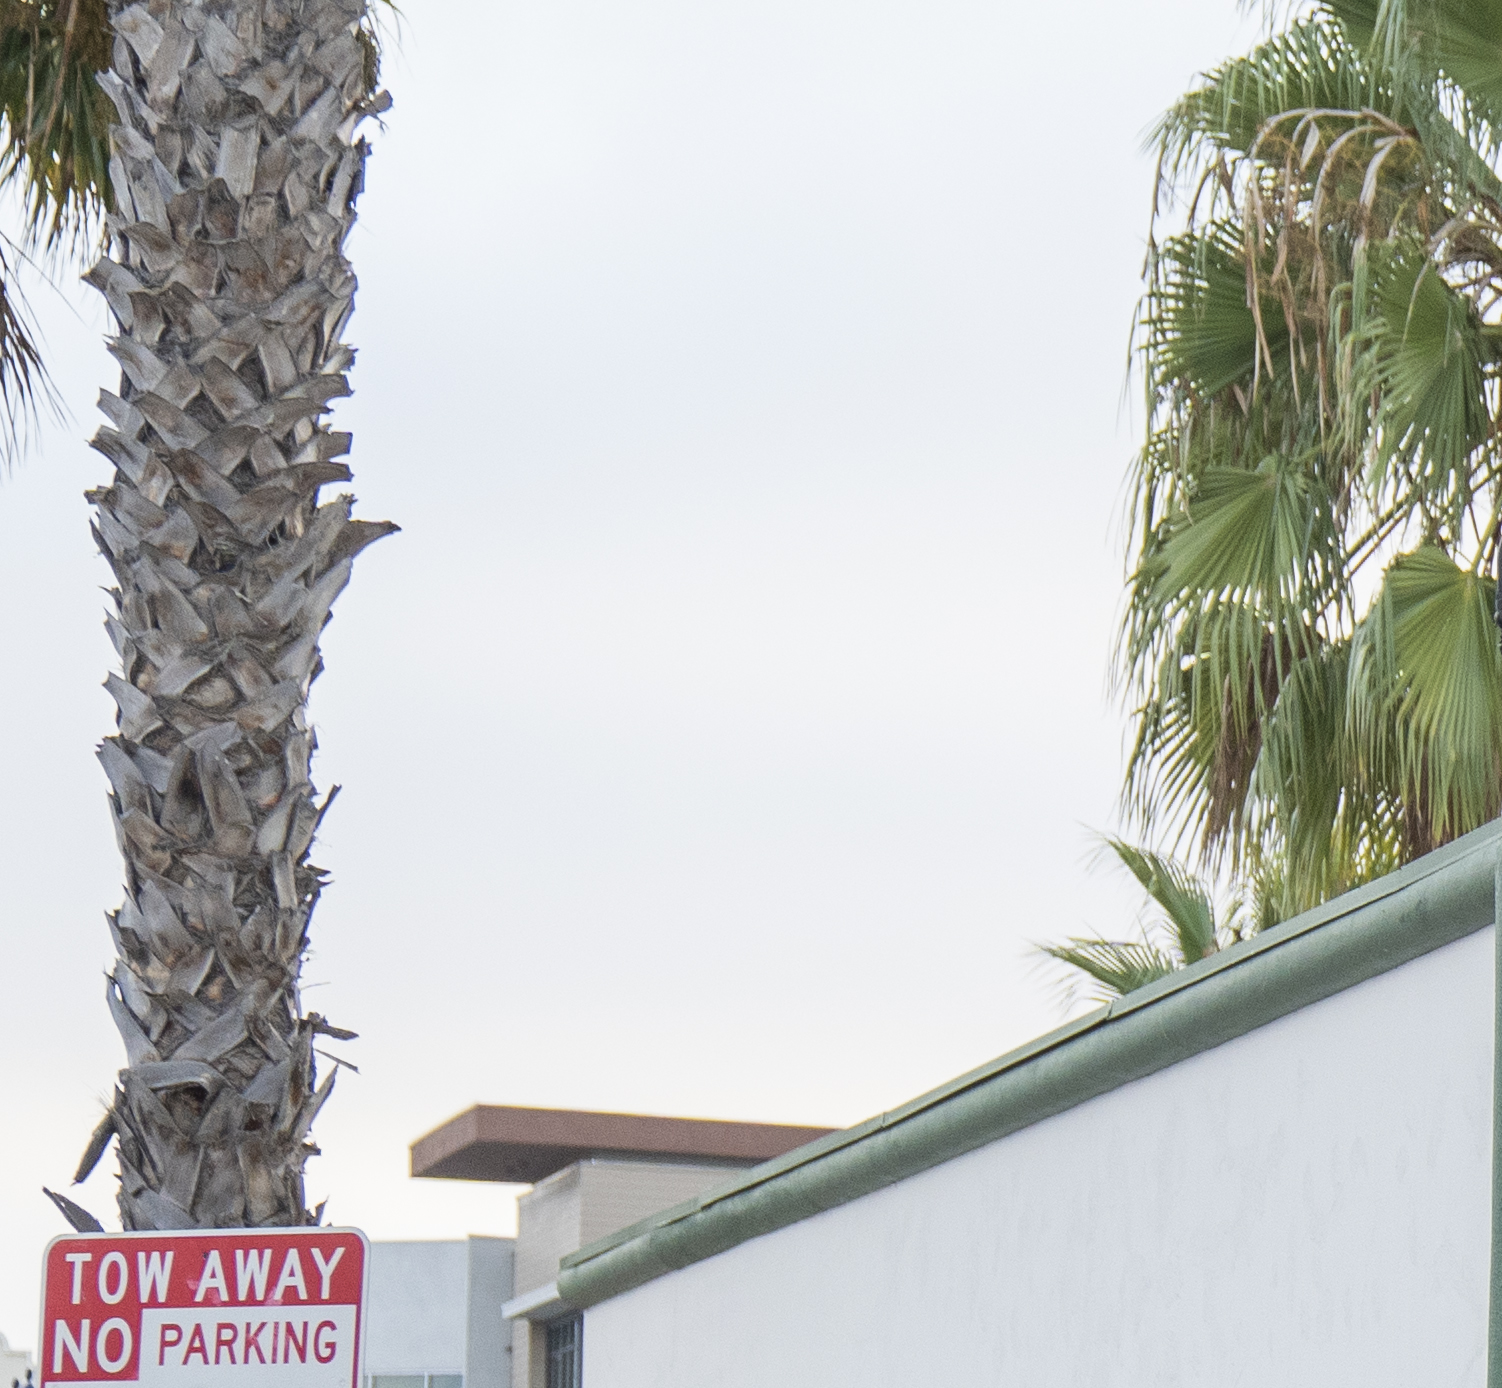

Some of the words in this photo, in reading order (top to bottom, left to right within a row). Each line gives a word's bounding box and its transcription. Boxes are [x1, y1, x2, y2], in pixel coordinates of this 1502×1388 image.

[65, 1250, 175, 1305] TOW
[194, 1246, 347, 1303] AWAY
[52, 1317, 133, 1374] NO
[158, 1320, 338, 1368] PARKING
